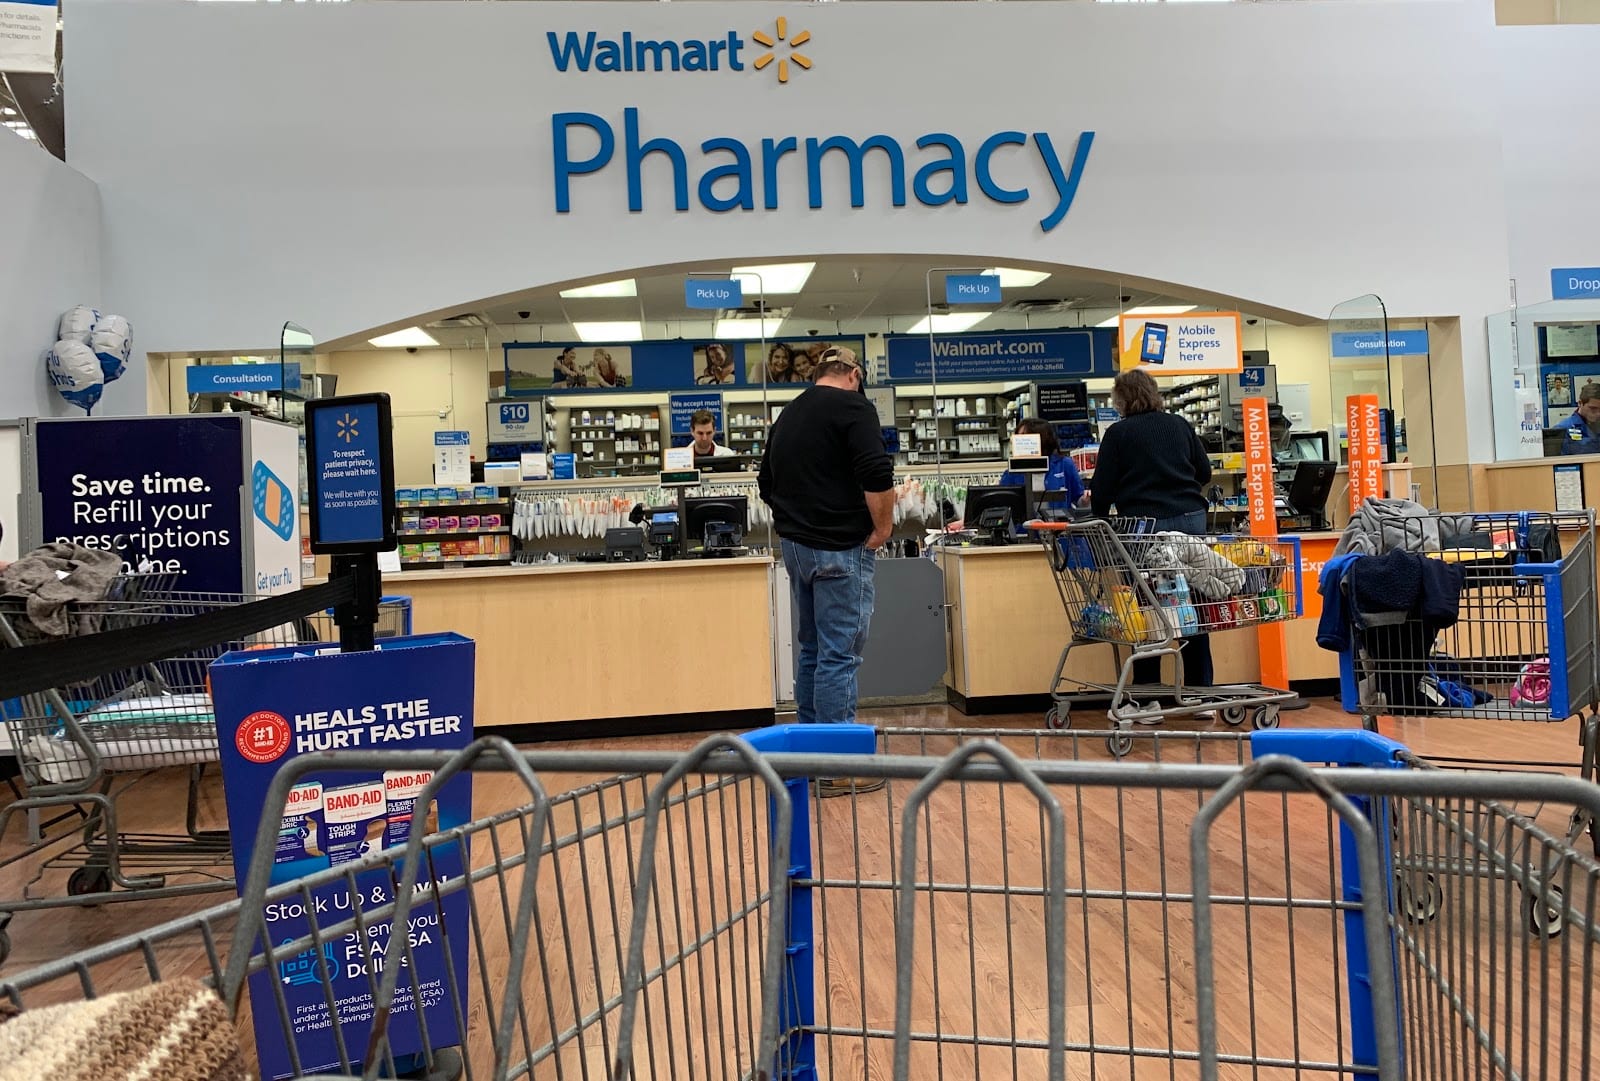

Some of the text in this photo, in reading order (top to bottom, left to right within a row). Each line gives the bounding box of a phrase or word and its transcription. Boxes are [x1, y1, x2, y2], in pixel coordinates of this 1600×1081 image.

[546, 31, 744, 72] Walmart
[552, 107, 1095, 232] Pharmacy
[959, 284, 990, 295] Pick Up
[1568, 277, 1600, 293] Drop
[696, 289, 730, 300] Pick Up
[1178, 325, 1216, 335] Mobile
[933, 340, 1045, 357] Walmart.com
[1178, 338, 1221, 350] Express
[1179, 352, 1204, 361] here
[212, 374, 273, 384] Consultation
[1244, 370, 1260, 383] $4
[502, 405, 527, 419] $10
[682, 400, 704, 408] accept
[1248, 407, 1265, 459] Mobile
[1350, 405, 1361, 455] Mobile
[1365, 404, 1380, 454] Mobile
[333, 449, 365, 458] To respect
[324, 459, 375, 470] patient privacy,
[322, 468, 377, 480] please wait here.
[71, 471, 211, 497] Save time.
[1248, 463, 1266, 521] Express
[323, 489, 379, 499] We will be with you
[331, 500, 346, 508] soon
[354, 498, 379, 508] possible.
[73, 499, 213, 528] Refill your
[257, 567, 293, 593] Get your flu
[240, 719, 252, 731] THE
[260, 713, 285, 727] DOCTOR
[295, 699, 430, 733] HEALS THE
[253, 725, 274, 741] #1
[296, 715, 461, 753] HURT FASTER
[238, 731, 289, 760] RECOMMENDED BRAND
[386, 772, 432, 790] BAND-AID
[327, 790, 382, 811] BAND-AID
[387, 798, 417, 808] FLEXIBLE
[388, 804, 412, 813] FABRIC
[328, 823, 357, 833] TOUGH
[328, 829, 357, 840] STRIPS
[371, 886, 386, 903] &
[407, 912, 446, 933] you
[345, 930, 433, 961] FSA/SA
[347, 955, 408, 979] Dolls
[296, 1002, 317, 1014] First
[334, 993, 372, 1007] products
[394, 987, 405, 995] be
[407, 979, 441, 993] cvered
[293, 1013, 319, 1025] under
[321, 1009, 341, 1020] yor
[420, 987, 445, 999] (FSA)
[295, 1025, 305, 1033] or
[338, 1012, 371, 1025] Savings
